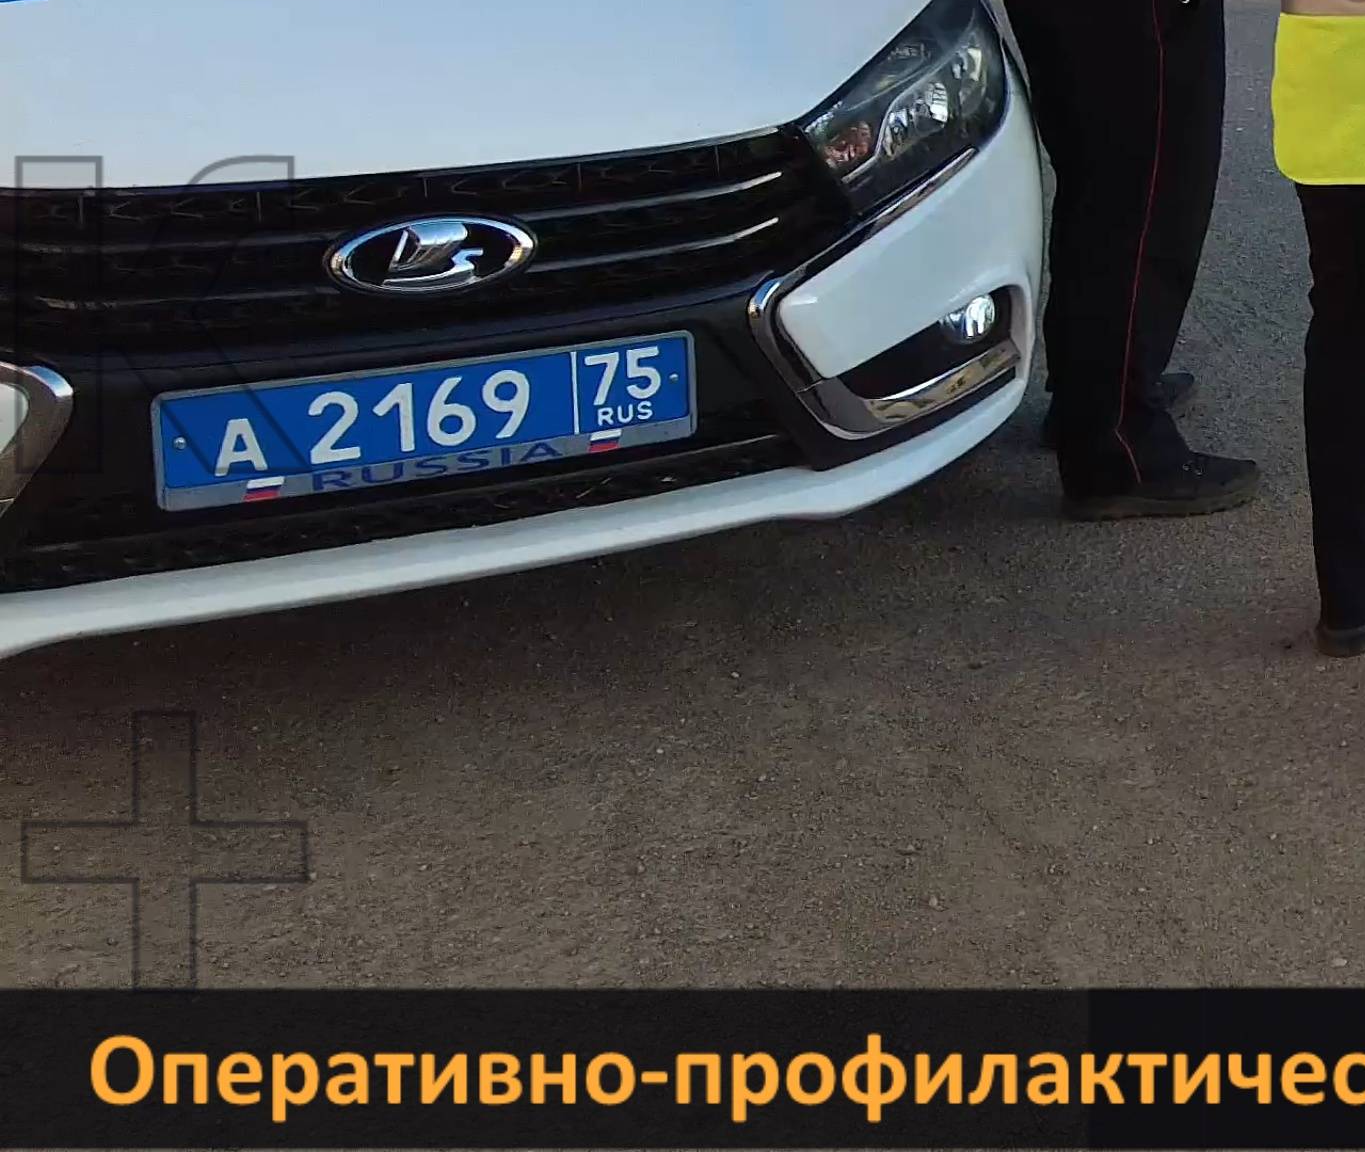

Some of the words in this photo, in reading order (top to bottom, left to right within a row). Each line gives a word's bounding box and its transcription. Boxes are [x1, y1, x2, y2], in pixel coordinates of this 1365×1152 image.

[307, 369, 531, 465] 2169
[584, 345, 662, 407] 75
[597, 400, 655, 427] RUS
[311, 439, 566, 493] RUSSIA
